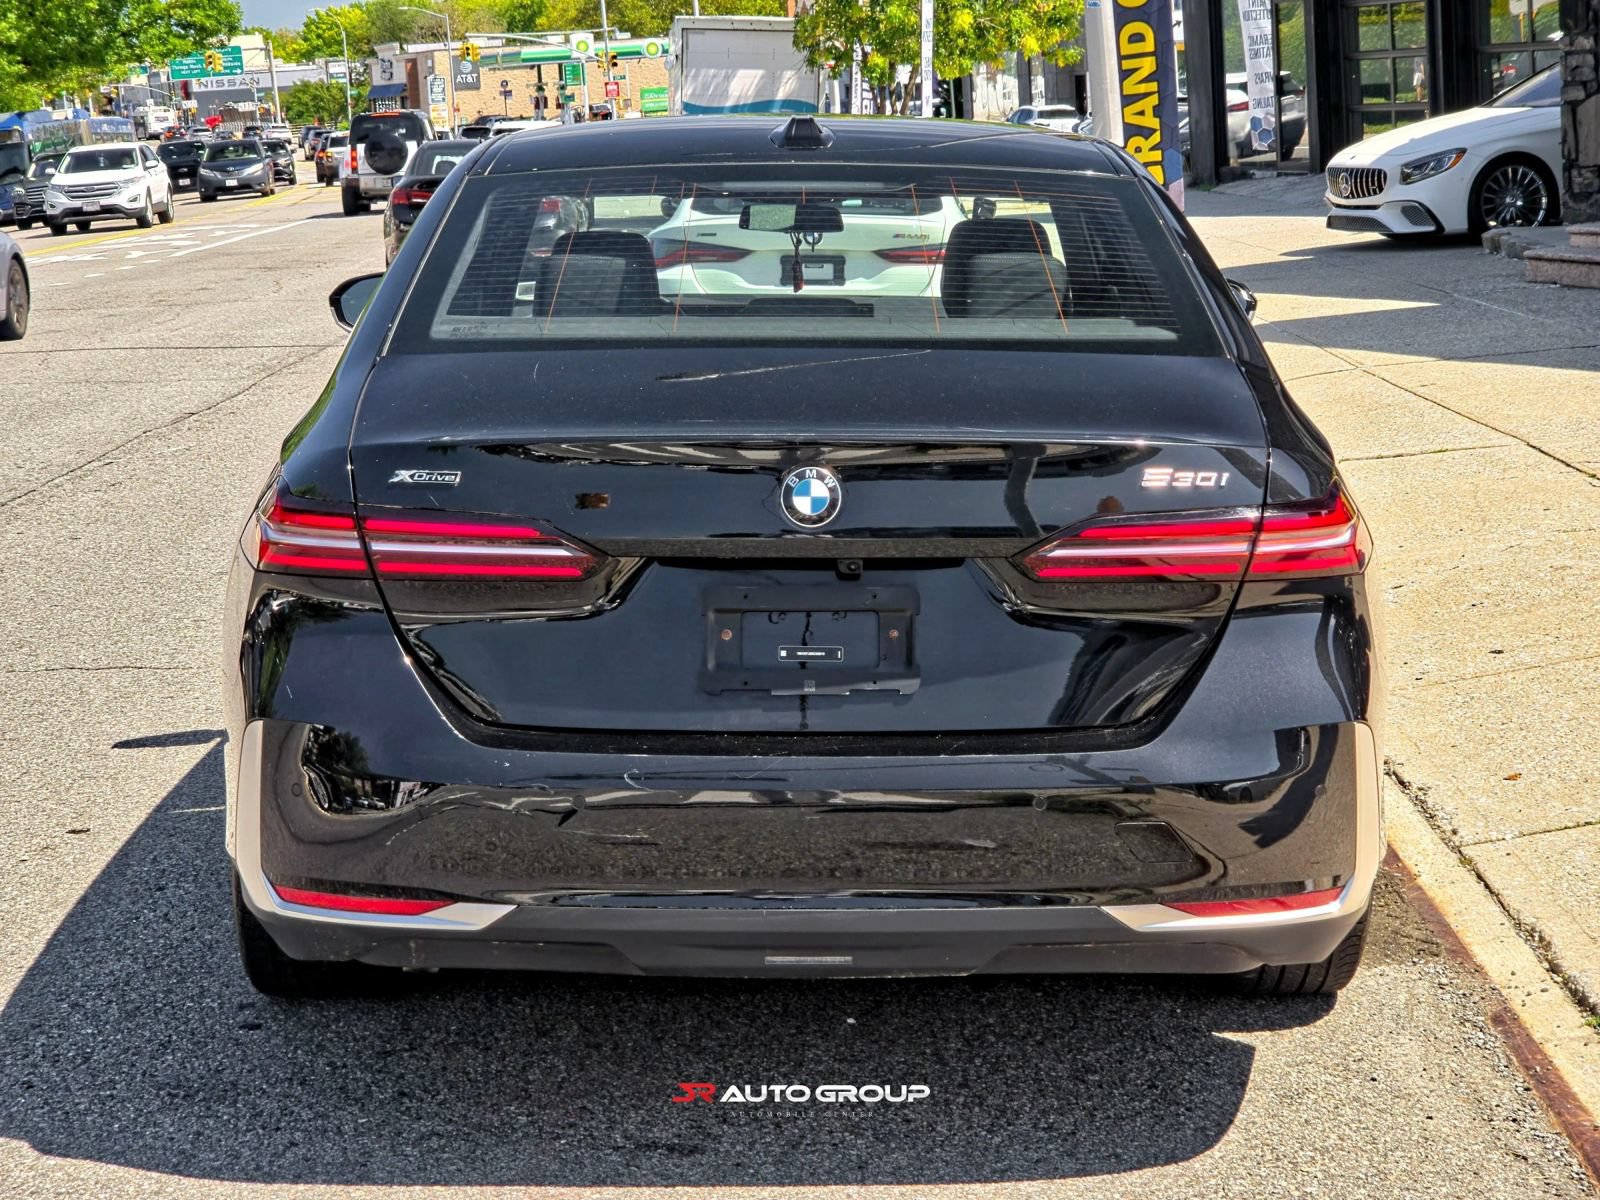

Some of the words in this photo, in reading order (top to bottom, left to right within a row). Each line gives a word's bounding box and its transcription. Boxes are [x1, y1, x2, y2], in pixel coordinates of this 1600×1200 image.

[199, 77, 260, 90] NISSAN
[456, 74, 478, 84] AT&T
[787, 469, 836, 488] BMW
